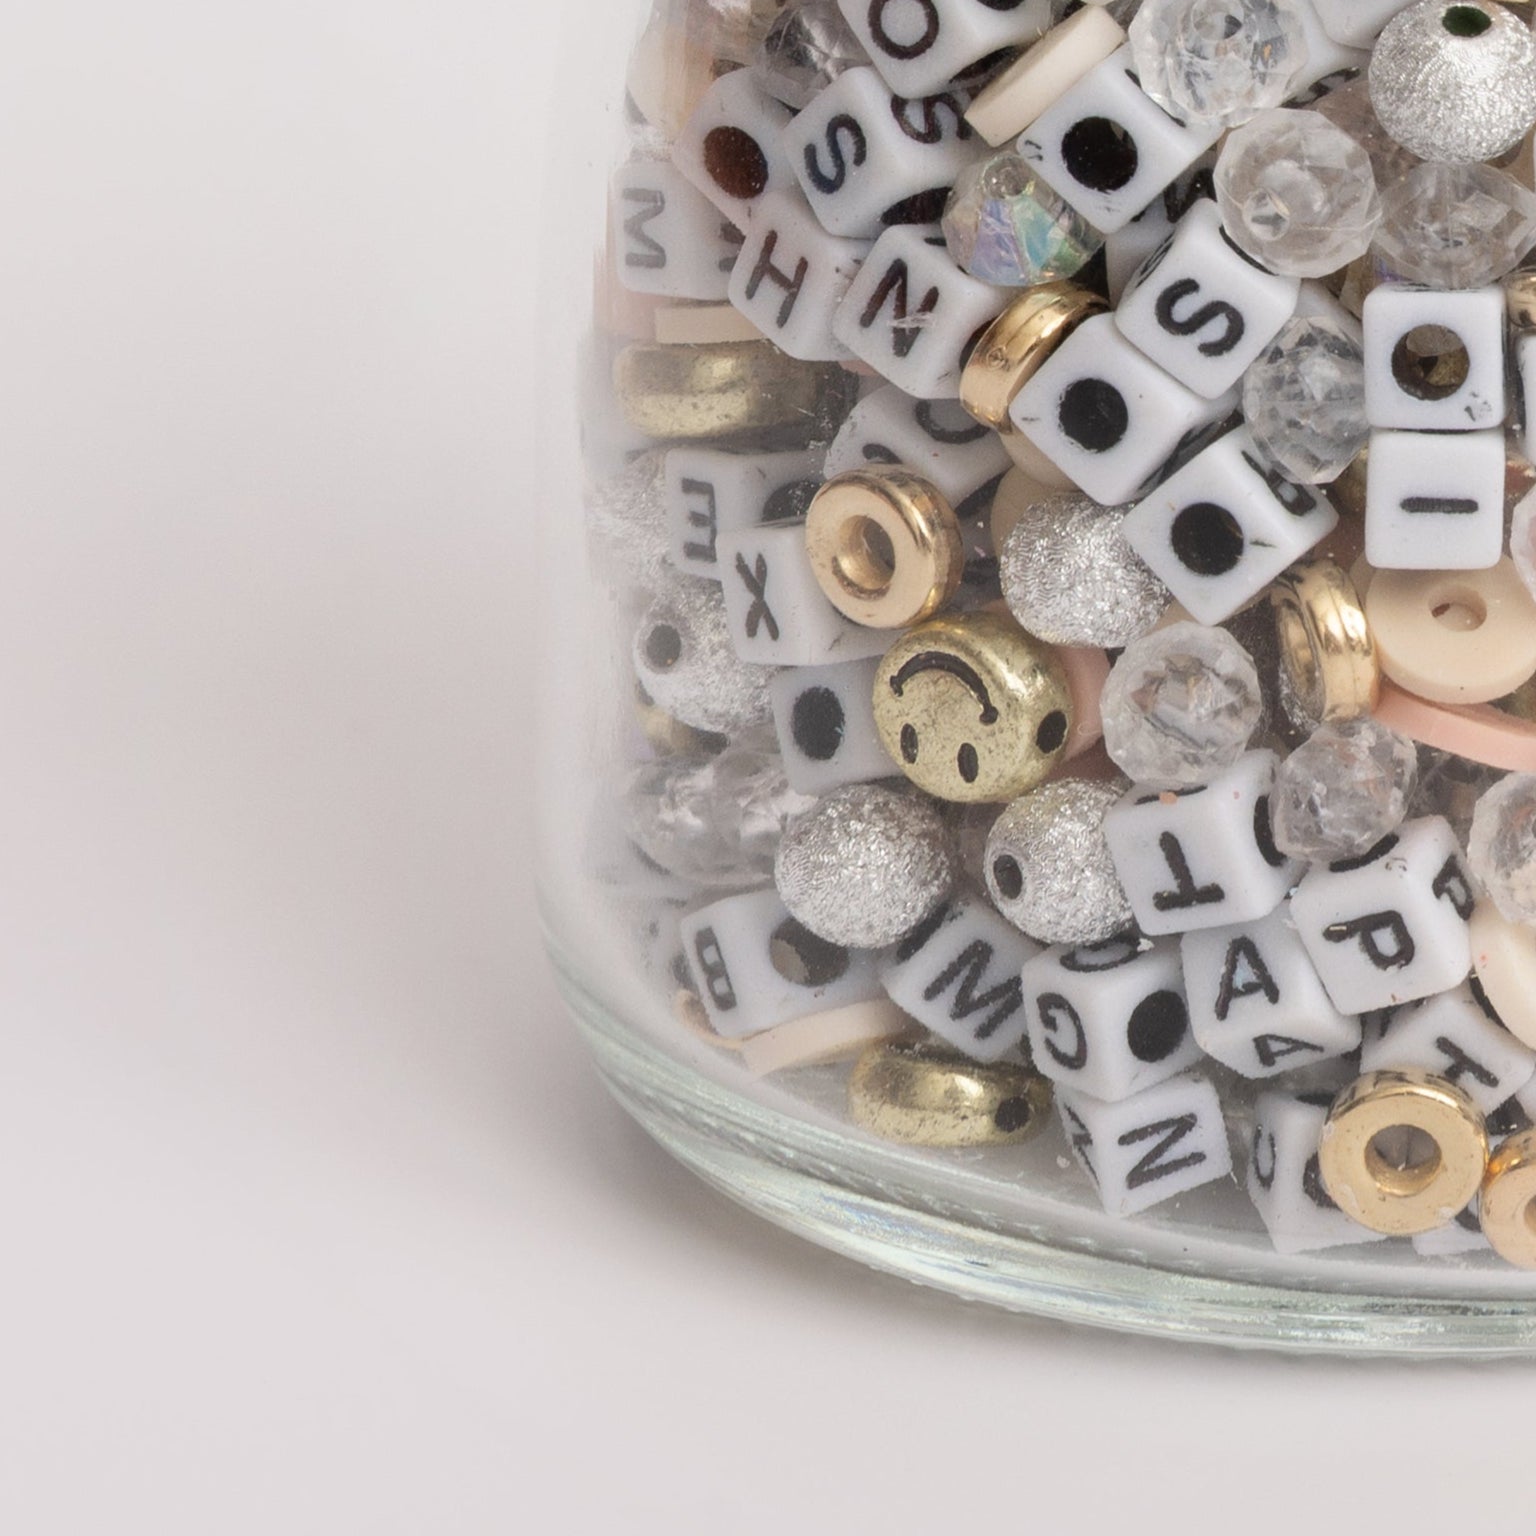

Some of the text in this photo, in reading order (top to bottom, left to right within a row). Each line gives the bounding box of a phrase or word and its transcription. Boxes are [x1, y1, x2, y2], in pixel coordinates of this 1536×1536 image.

[803, 112, 868, 195] S
[744, 228, 809, 329] H
[1154, 277, 1247, 358] S
[734, 551, 780, 642] X
[1152, 830, 1226, 912] T
[1213, 934, 1281, 1022] A
[1322, 909, 1416, 972] P
[1036, 991, 1088, 1072] G
